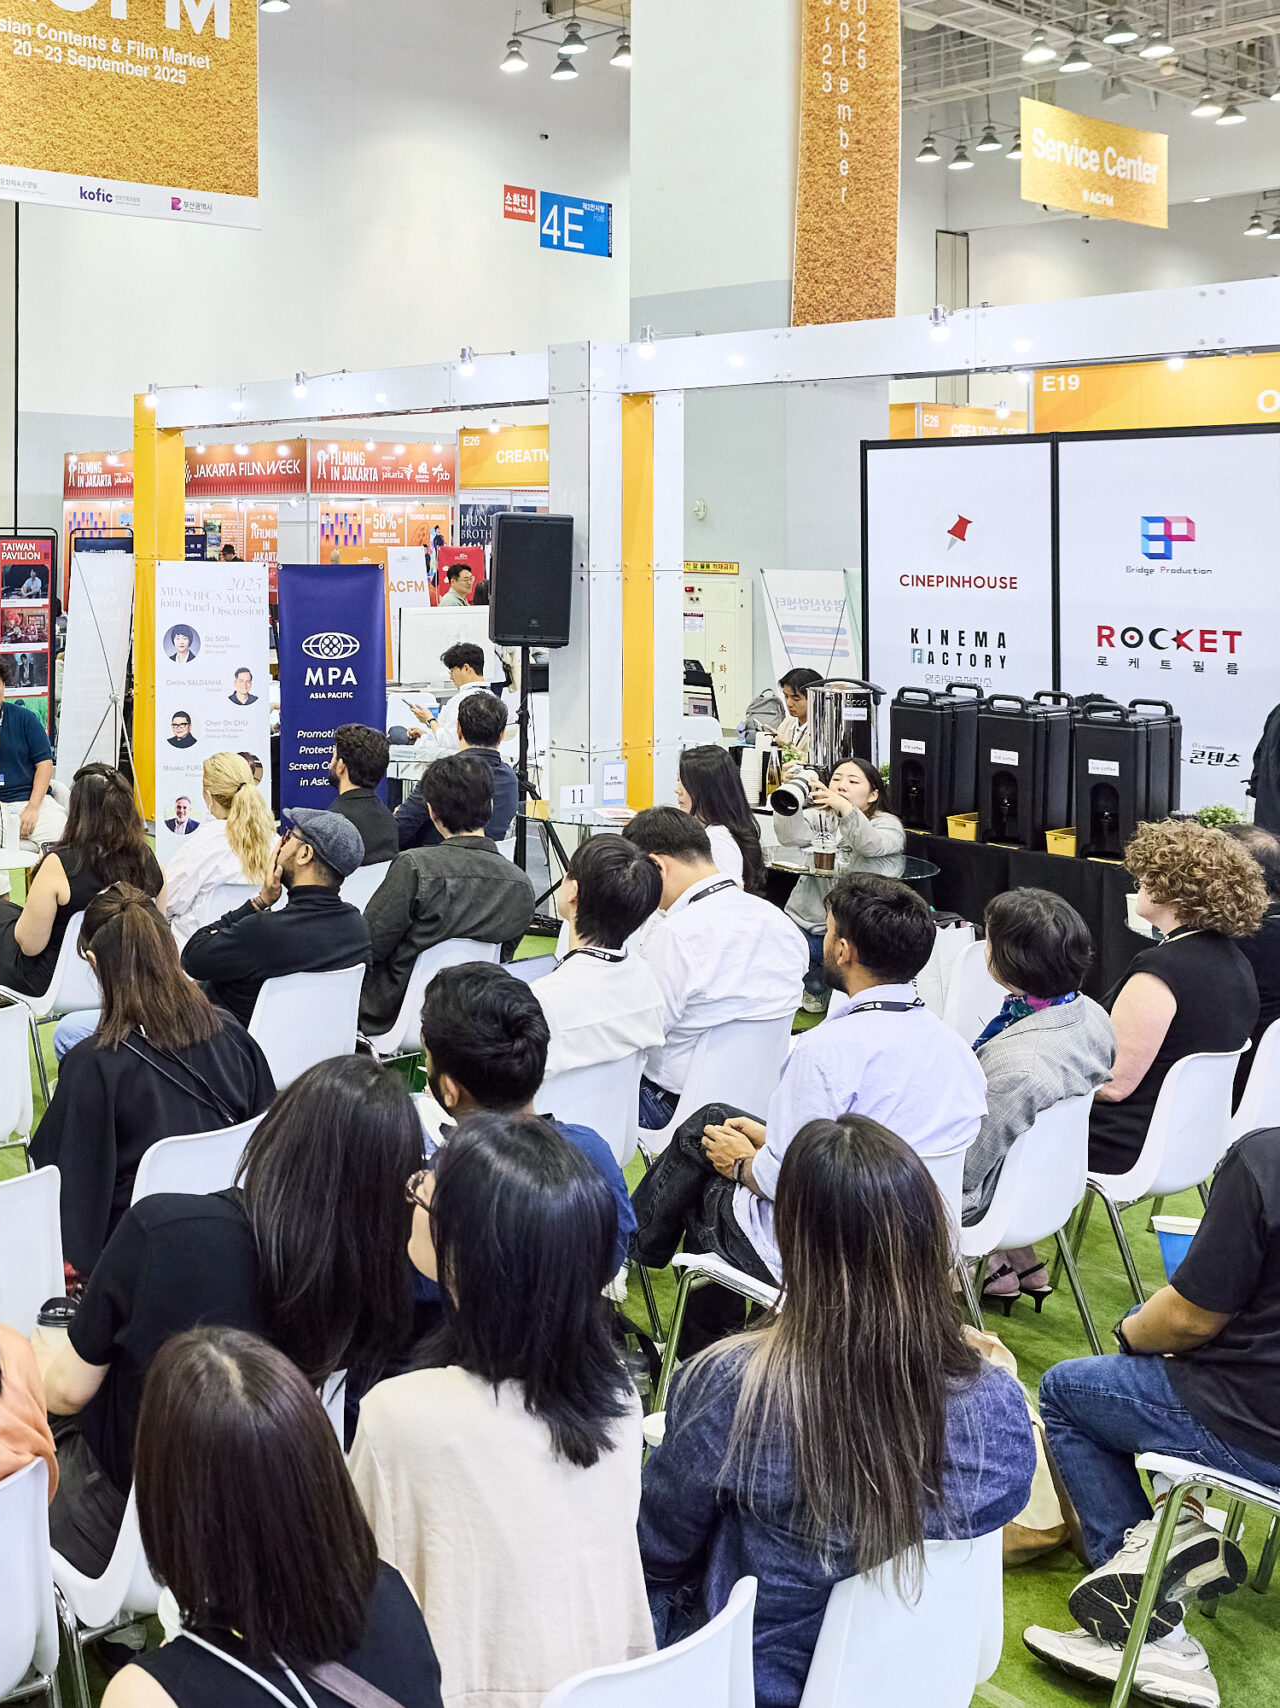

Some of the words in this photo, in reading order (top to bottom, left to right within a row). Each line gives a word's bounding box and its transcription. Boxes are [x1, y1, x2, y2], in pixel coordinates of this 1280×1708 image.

[36, 22, 107, 51] Contents
[110, 38, 123, 53] &
[127, 39, 158, 61] Film
[162, 45, 211, 70] Market
[67, 49, 150, 80] September
[153, 64, 187, 85] 2025
[1032, 127, 1100, 172] Service
[1104, 146, 1159, 185] Center
[80, 186, 113, 203] kofic
[505, 192, 528, 208] 소화전
[183, 201, 213, 212] 부산광역시
[541, 204, 585, 250] 4E
[1042, 374, 1080, 393] E19
[923, 414, 939, 428] E26
[463, 436, 480, 446] E26
[330, 451, 366, 466] FILMING
[77, 460, 103, 474] FILMING
[193, 462, 237, 478] JAKARTA
[239, 461, 266, 476] FILM
[266, 459, 301, 475] WEEK
[330, 467, 340, 481] IN
[342, 466, 378, 482] JAKARTA
[77, 475, 84, 488] IN
[85, 474, 112, 488] JAKARTA
[381, 470, 404, 481] jakarta
[373, 513, 397, 530] 50%
[256, 528, 278, 539] FILMIN
[1, 542, 36, 551] TAIWAN
[263, 541, 270, 550] IN
[1, 551, 41, 560] PAVILION
[1125, 565, 1155, 576] Bridge
[1160, 565, 1213, 576] Production
[227, 577, 263, 591] 2025
[389, 580, 425, 593] ACFM
[899, 574, 1018, 590] CINEPINHOUSE
[160, 586, 184, 597] MPA
[224, 594, 262, 604] AFCNet
[160, 599, 181, 609] Joint
[184, 602, 210, 612] Panel
[212, 606, 264, 616] Discussion
[911, 628, 1006, 648] KINEMA
[1097, 624, 1242, 654] ROCKET
[718, 643, 727, 694] 소화기
[305, 667, 358, 686] MPA
[297, 729, 335, 739] Promoti
[299, 745, 336, 755] Protecti
[1189, 749, 1242, 767] 콘텐츠
[289, 761, 320, 771] Screen
[300, 777, 309, 786] in
[571, 789, 585, 804] 11
